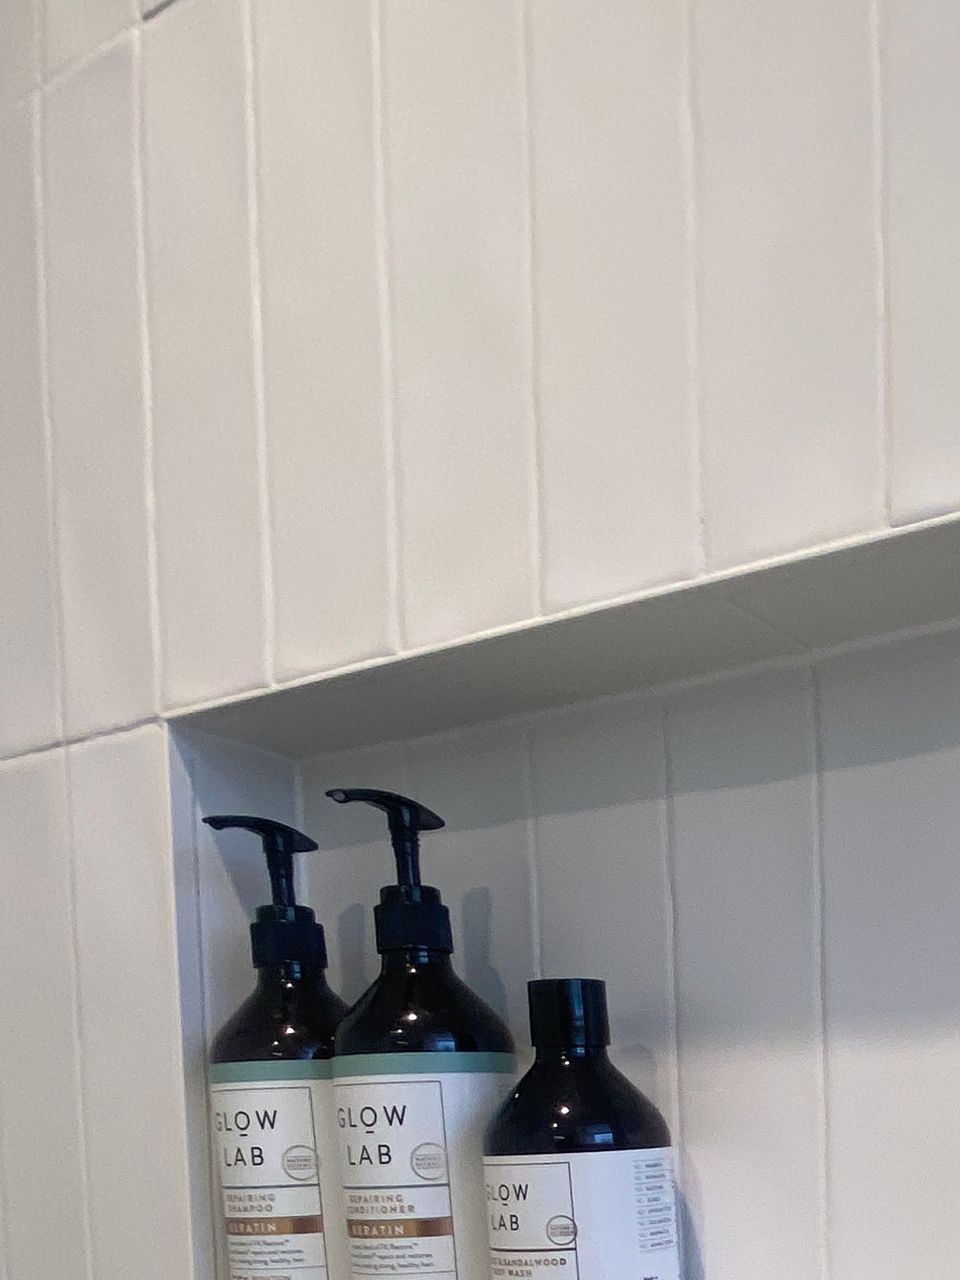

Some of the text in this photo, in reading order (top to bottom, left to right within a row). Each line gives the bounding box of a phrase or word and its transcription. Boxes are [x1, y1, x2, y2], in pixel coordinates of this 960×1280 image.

[216, 1110, 277, 1136] GLOW
[337, 1105, 406, 1134] GLOW
[224, 1147, 264, 1167] LAB
[347, 1144, 393, 1166] LAB
[350, 1225, 405, 1236] KERATIN
[491, 1214, 520, 1231] LAB
